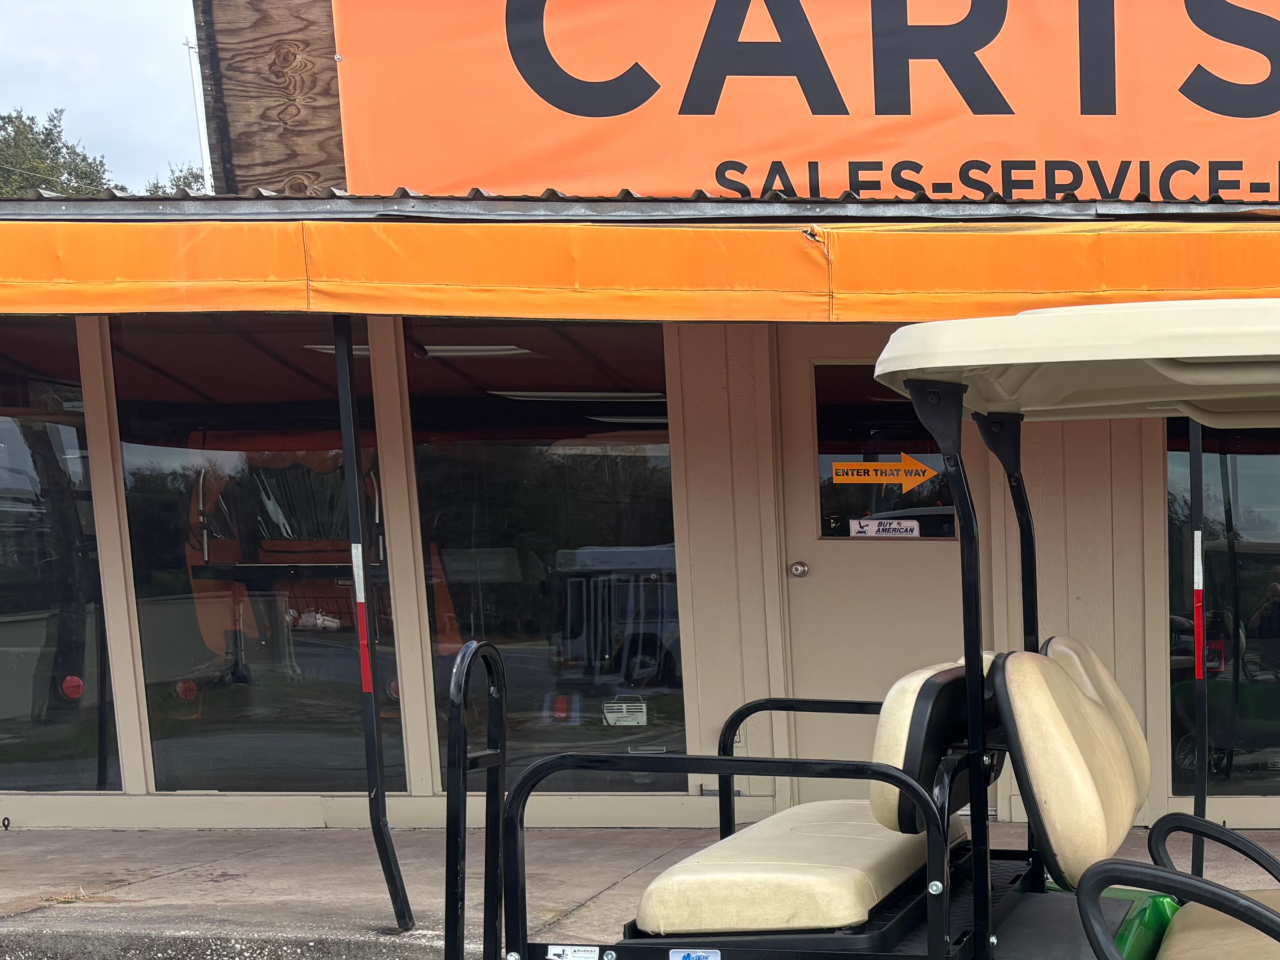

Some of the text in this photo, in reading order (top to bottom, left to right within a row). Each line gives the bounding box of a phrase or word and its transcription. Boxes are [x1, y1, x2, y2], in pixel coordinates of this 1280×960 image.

[835, 469, 927, 477] ENTER THAT WAY
